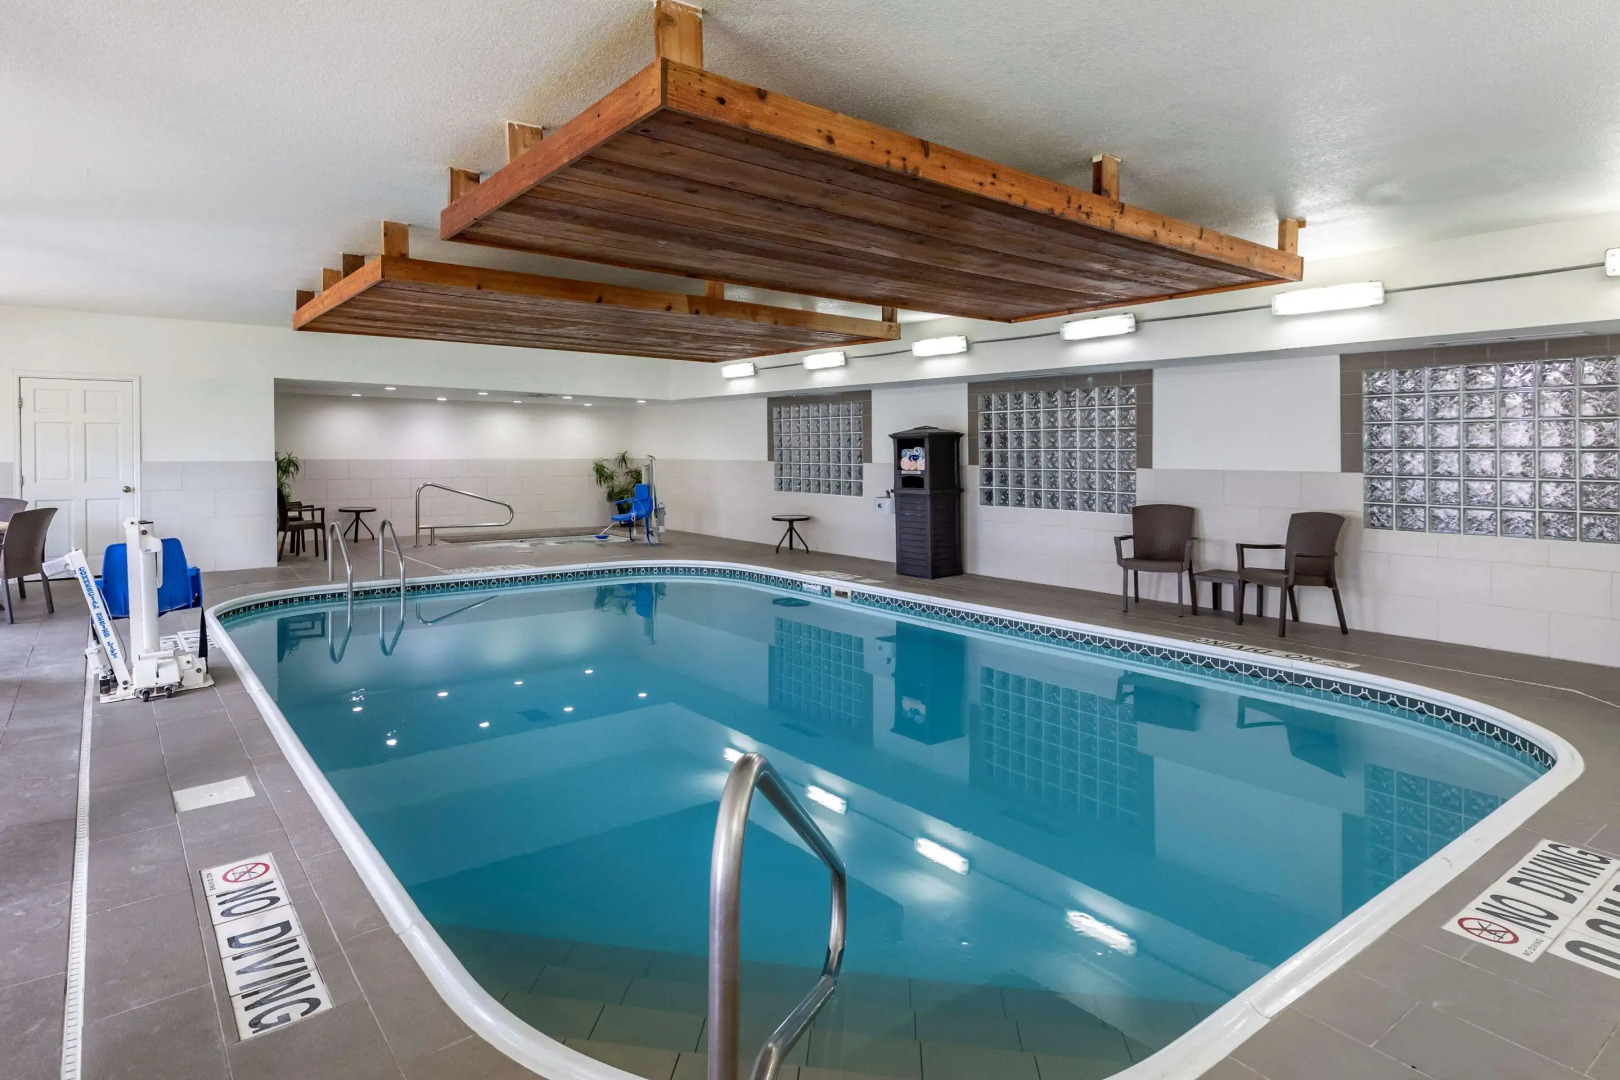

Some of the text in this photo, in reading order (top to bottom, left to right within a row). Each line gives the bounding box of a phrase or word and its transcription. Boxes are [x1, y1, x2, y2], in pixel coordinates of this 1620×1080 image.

[1191, 637, 1322, 663] NO DIVING
[1506, 843, 1612, 905] DIVING
[1475, 894, 1559, 935] NO
[215, 880, 322, 1035] NO DIVING
